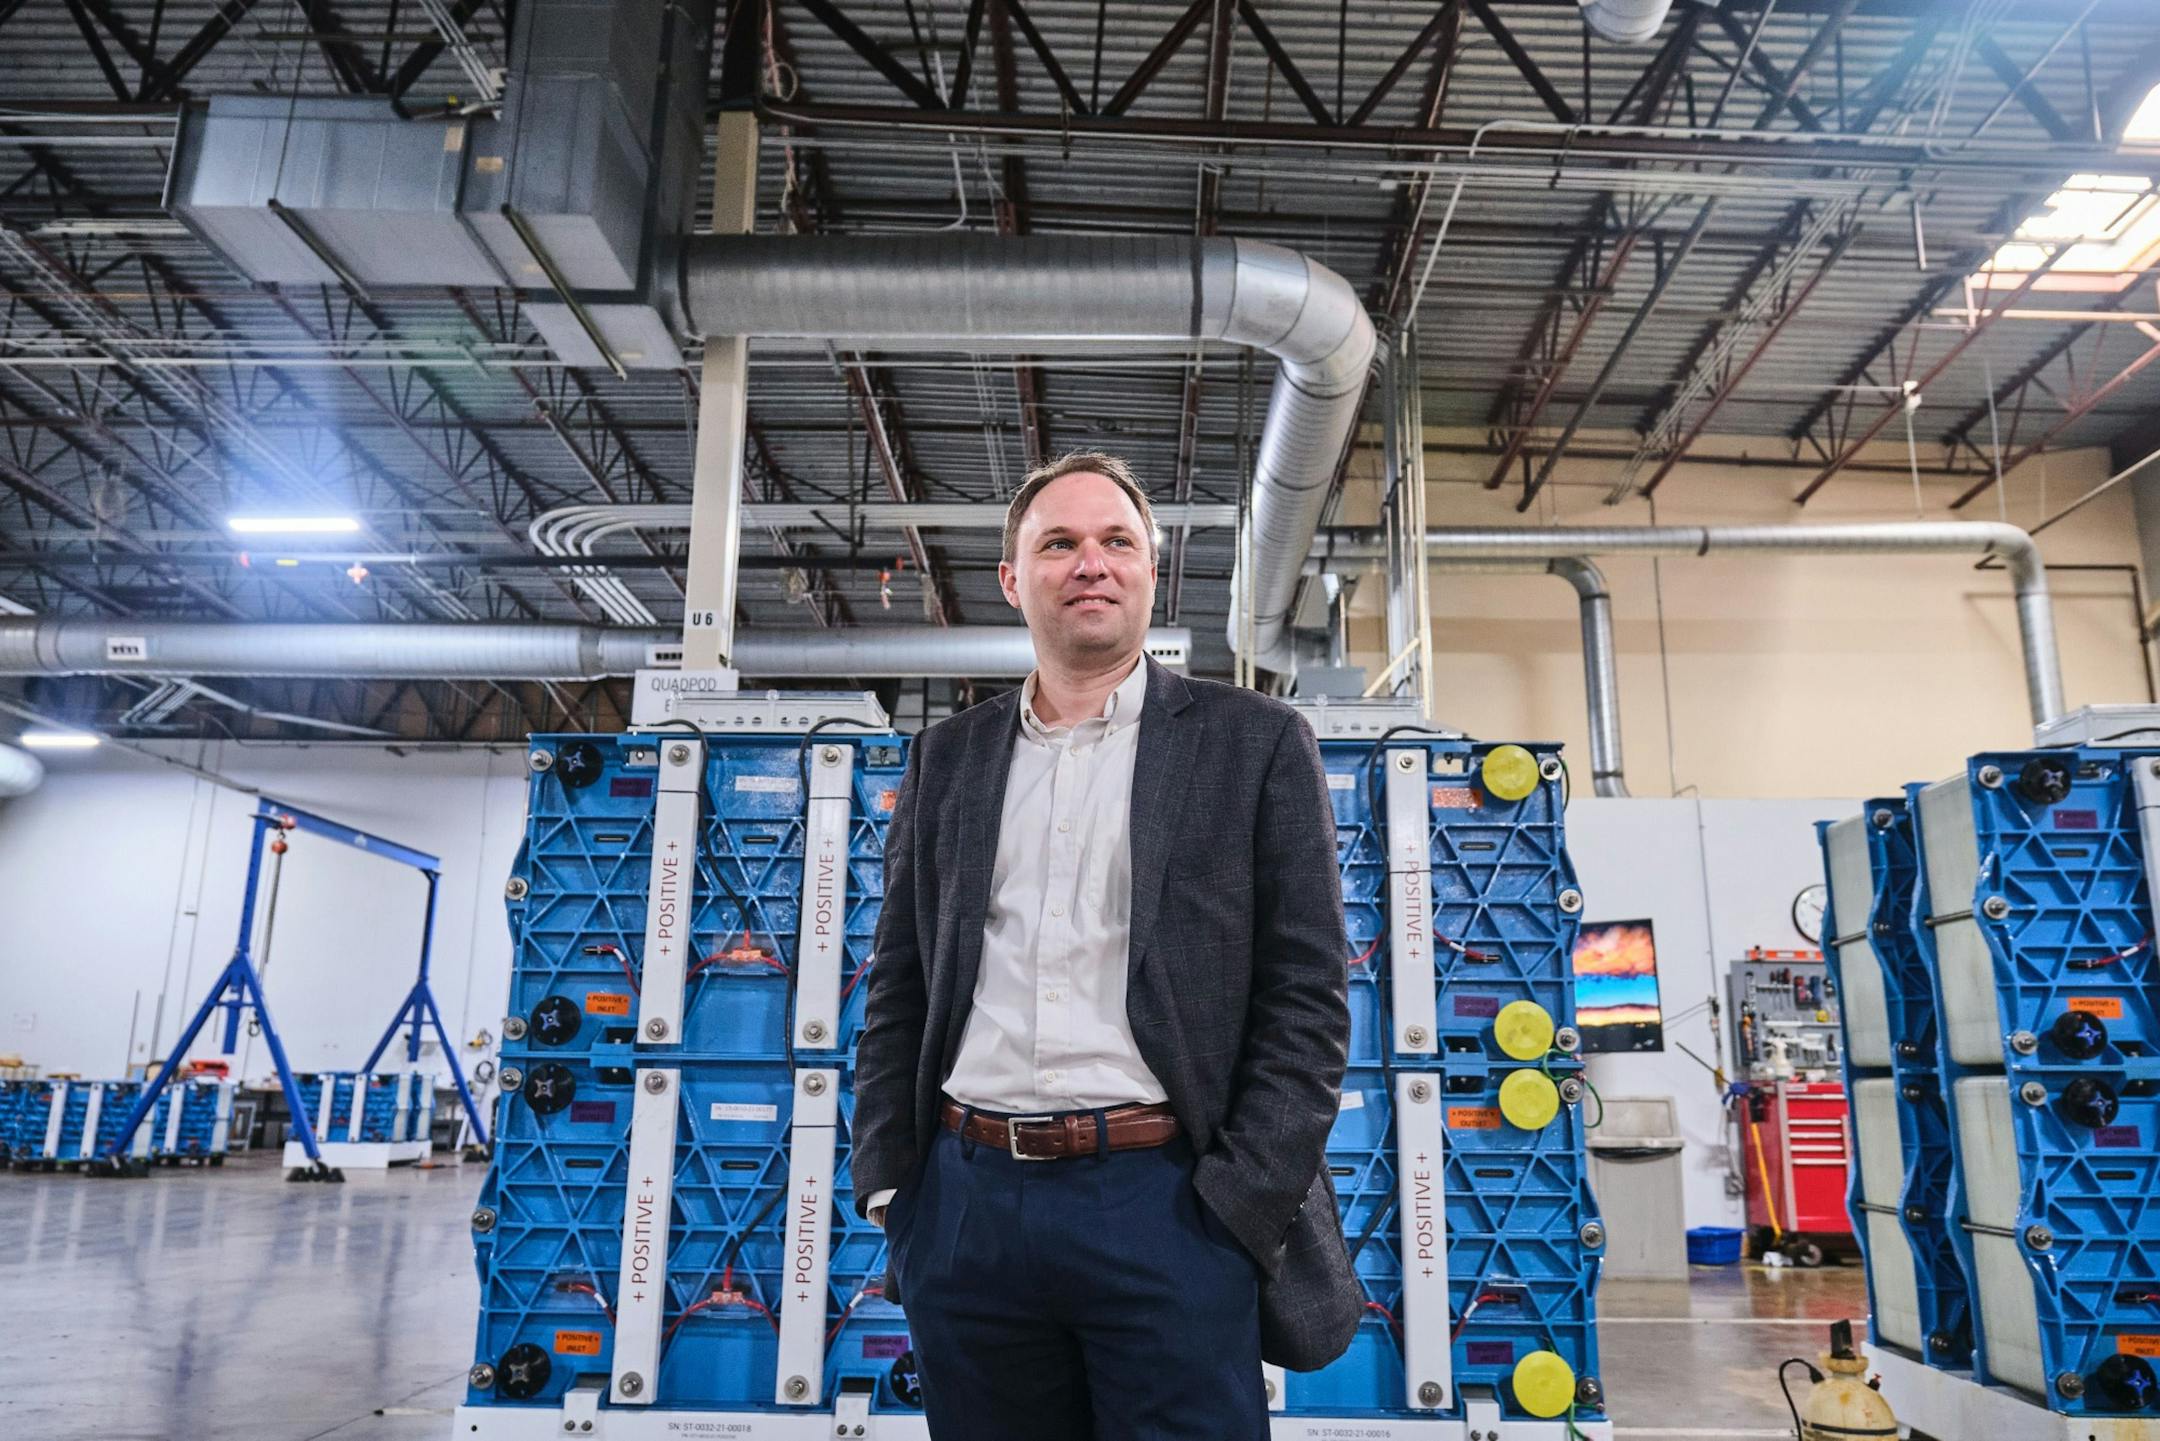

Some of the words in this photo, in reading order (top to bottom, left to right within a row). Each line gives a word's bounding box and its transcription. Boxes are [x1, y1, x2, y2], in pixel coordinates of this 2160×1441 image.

[651, 677, 717, 692] QUADPOD
[658, 858, 678, 939] POSITIVE
[815, 855, 834, 936] POSITIVE
[1405, 861, 1422, 942] POSITIVE
[632, 1195, 653, 1284] POSITIVE
[795, 1194, 817, 1284] POSITIVE
[1414, 1171, 1434, 1260] POSITIVE
